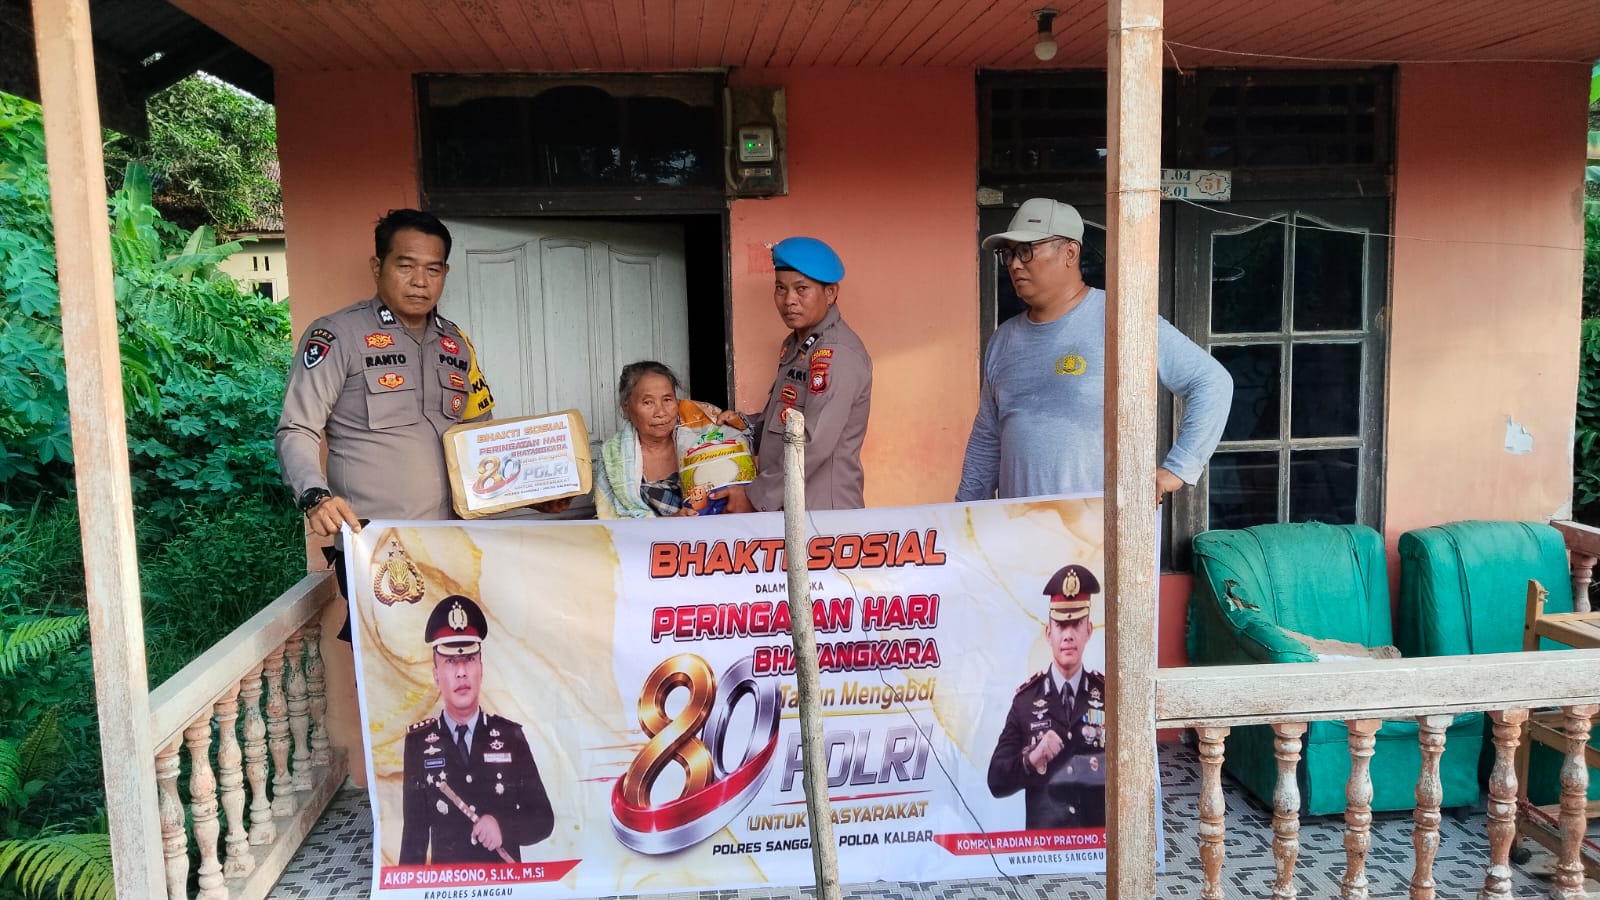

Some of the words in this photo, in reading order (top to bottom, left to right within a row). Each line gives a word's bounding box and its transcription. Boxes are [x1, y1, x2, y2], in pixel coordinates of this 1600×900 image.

[1204, 178, 1222, 191] 51
[365, 354, 406, 367] RANTO
[439, 354, 468, 371] POLRI
[477, 429, 520, 443] BHAKTI
[524, 421, 567, 435] SOSIAL
[479, 438, 541, 455] PERINGATAN
[543, 434, 566, 445] HARI
[476, 454, 521, 494] 80
[523, 461, 569, 480] POLRI
[807, 528, 946, 570] SOSIAL
[755, 583, 786, 594] DALAM
[652, 597, 854, 643] PERINGAAN
[862, 593, 939, 631] HARI
[752, 638, 941, 677] BHANGKARA
[840, 677, 937, 709] Mengabdi
[622, 652, 781, 816] 80
[747, 813, 807, 832] UNTUK
[831, 801, 928, 825] ASYARAKAT
[713, 842, 761, 855] POLRES
[766, 838, 812, 852] SANGG
[839, 832, 879, 847] POLDA
[884, 830, 933, 843] KALBAR
[957, 838, 995, 850] KOMPOL
[997, 837, 1032, 848] RADIAN
[1034, 836, 1053, 847] ADY
[1008, 855, 1062, 865] WAKAPOLRES
[1065, 851, 1104, 862] SANGGAU
[384, 871, 413, 885] AKBP
[523, 866, 544, 878] M.Si
[424, 889, 468, 899] KAPOLRES
[471, 887, 513, 898] SANGGAU
